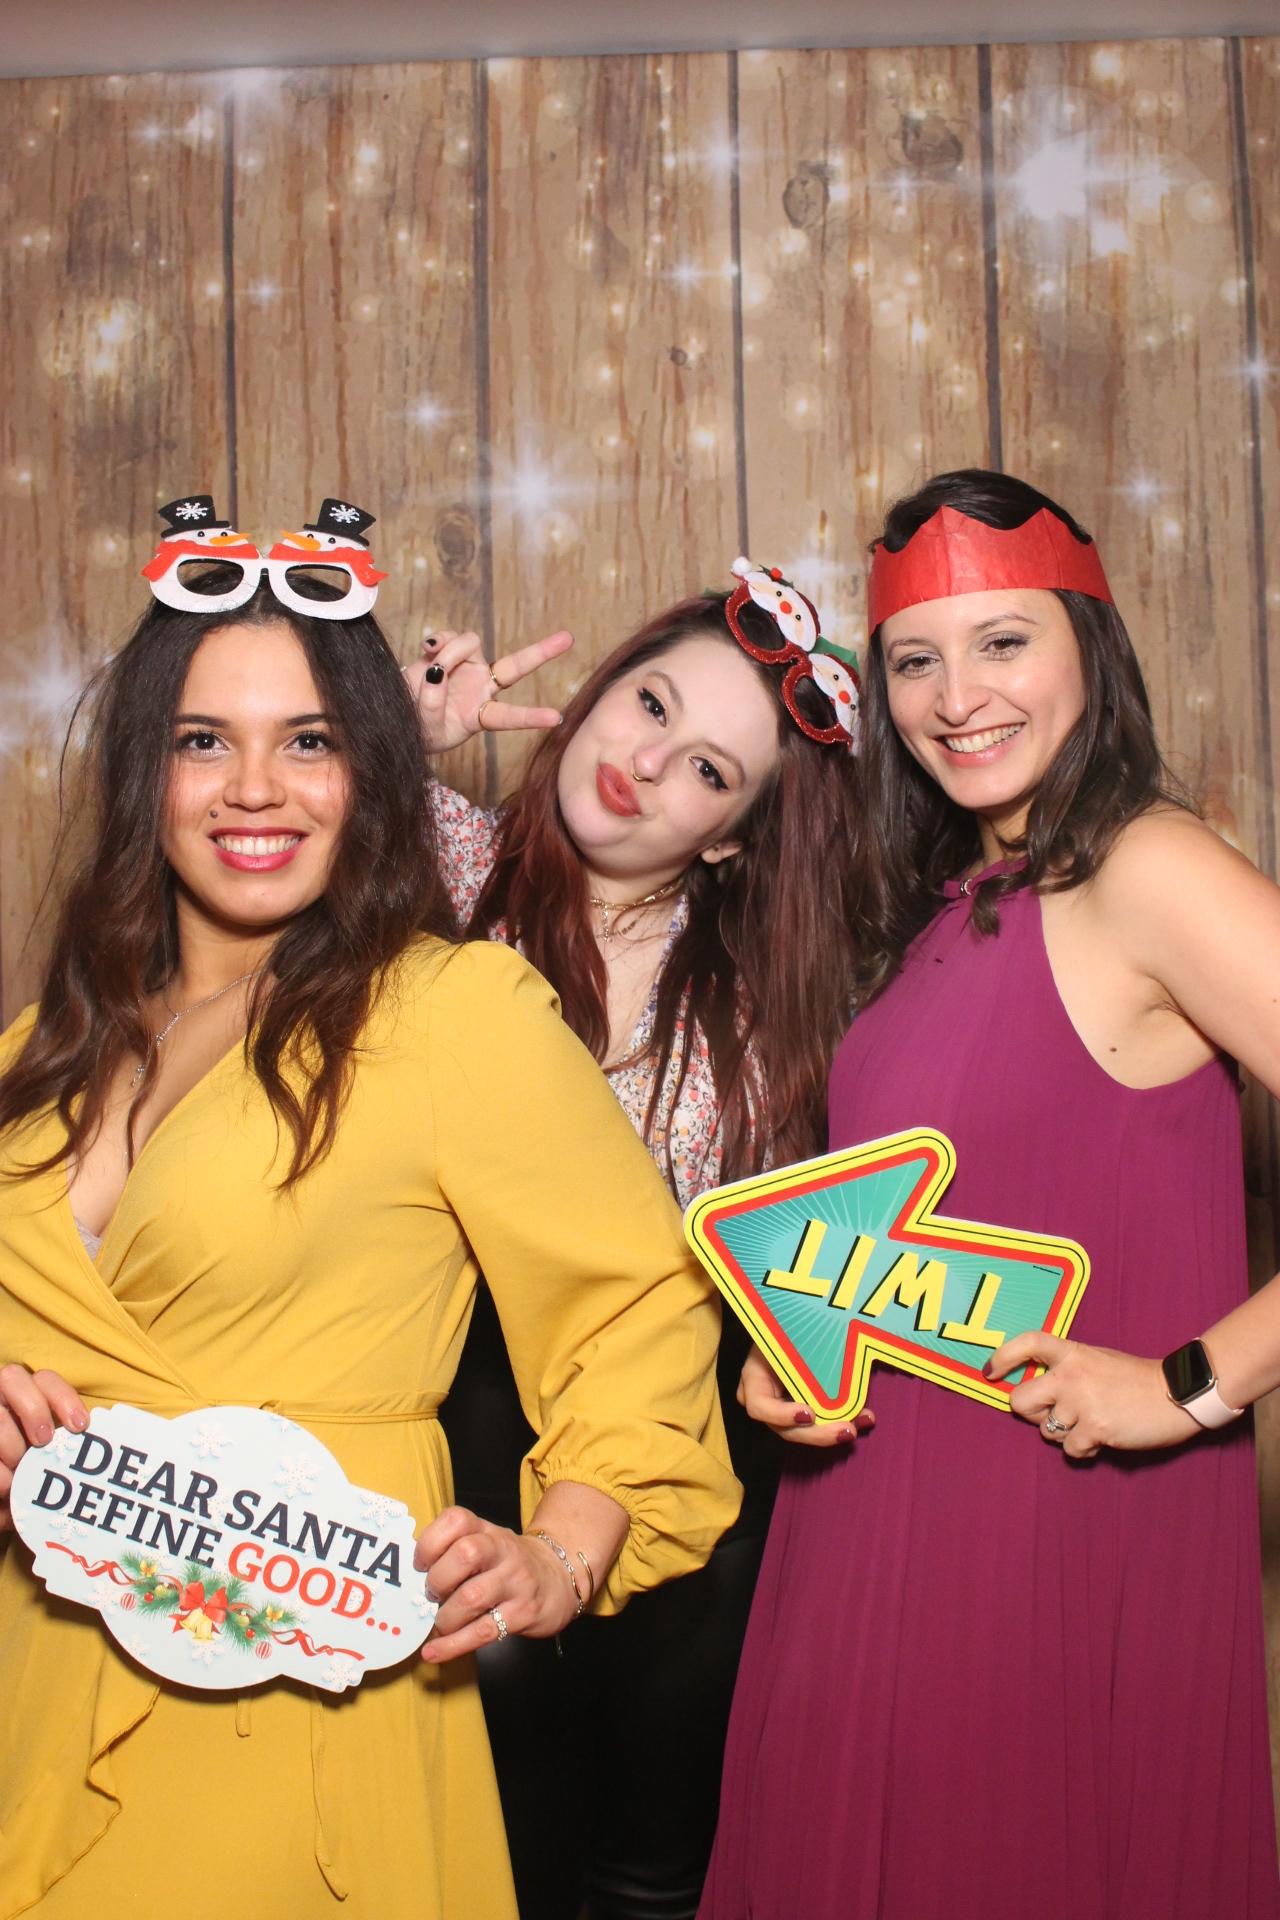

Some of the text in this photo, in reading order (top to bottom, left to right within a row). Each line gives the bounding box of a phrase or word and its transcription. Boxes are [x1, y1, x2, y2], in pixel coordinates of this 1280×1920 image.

[762, 1218, 1005, 1348] TWIT
[31, 1469, 402, 1636] DEFINE GOOD...
[69, 1432, 402, 1588] DEAR SANTA
